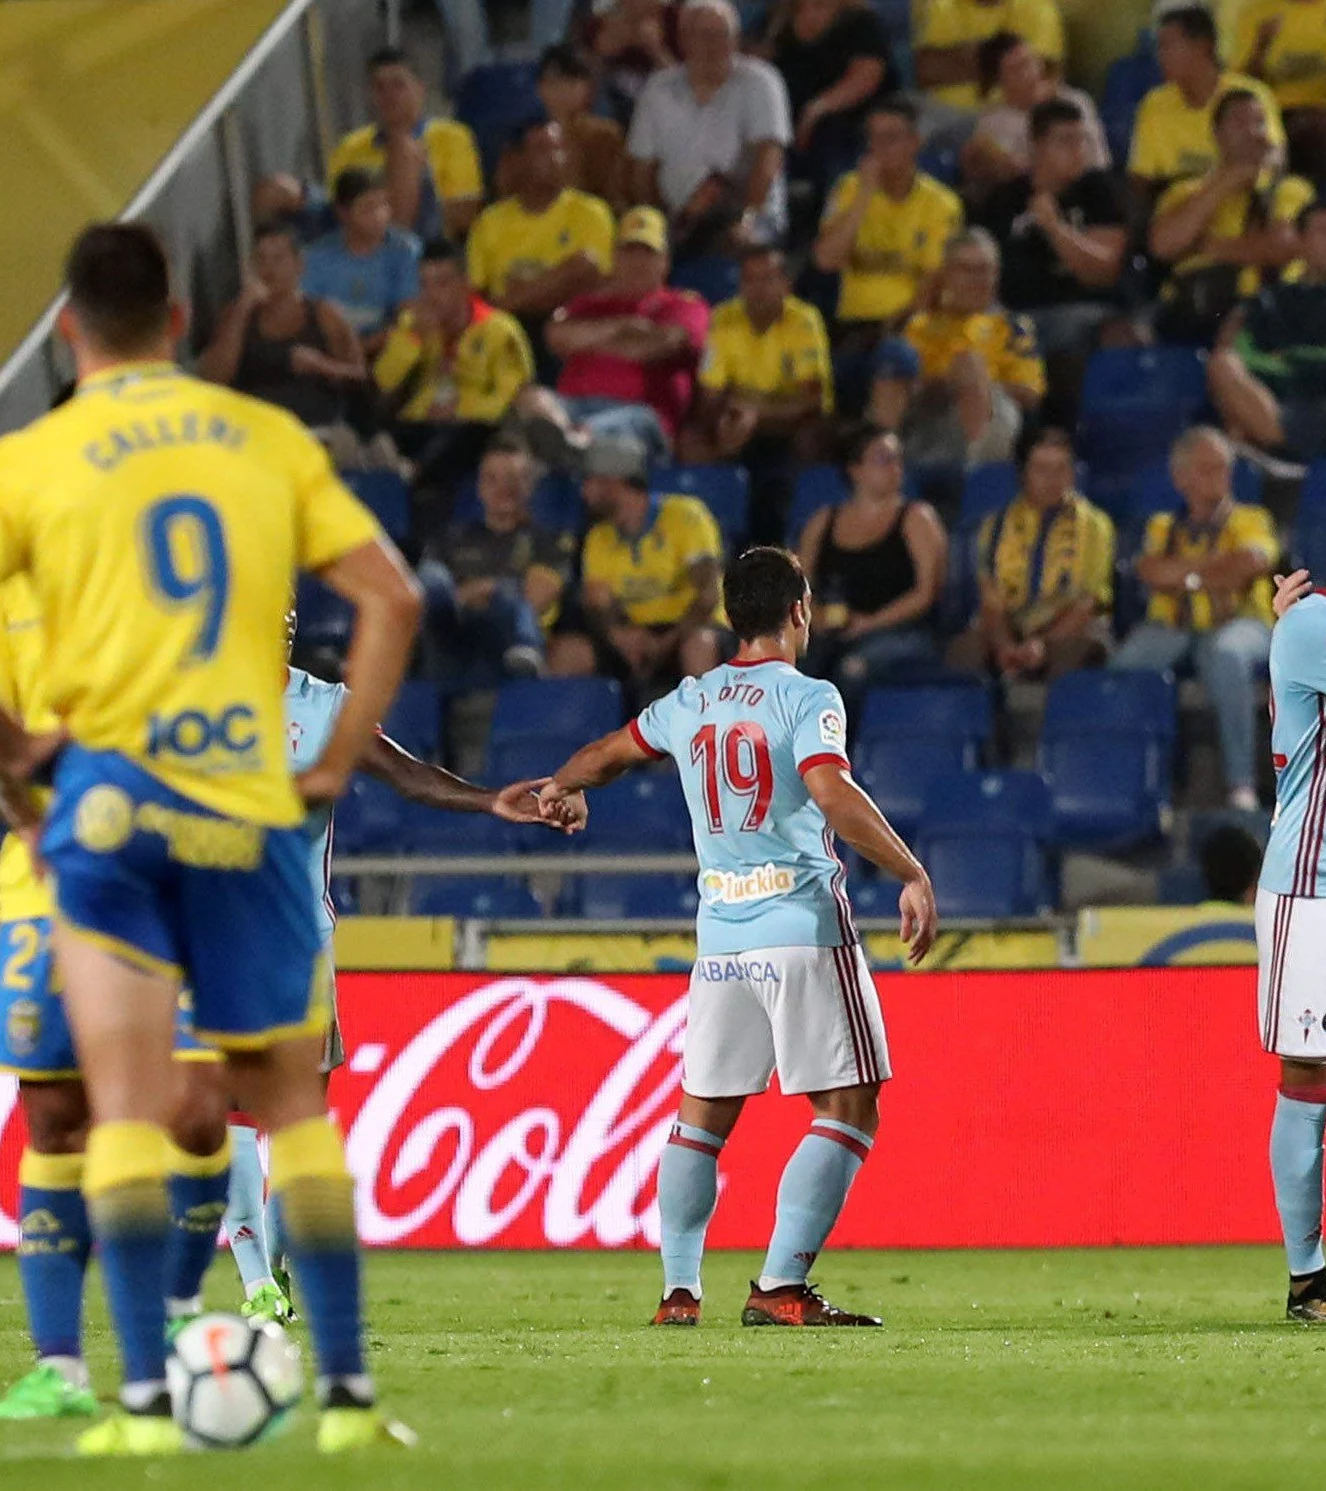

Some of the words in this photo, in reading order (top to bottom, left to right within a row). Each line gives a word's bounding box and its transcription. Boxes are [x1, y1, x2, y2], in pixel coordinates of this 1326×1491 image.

[145, 494, 231, 664] 9
[690, 721, 774, 834] 19
[697, 960, 780, 983] ABANCA
